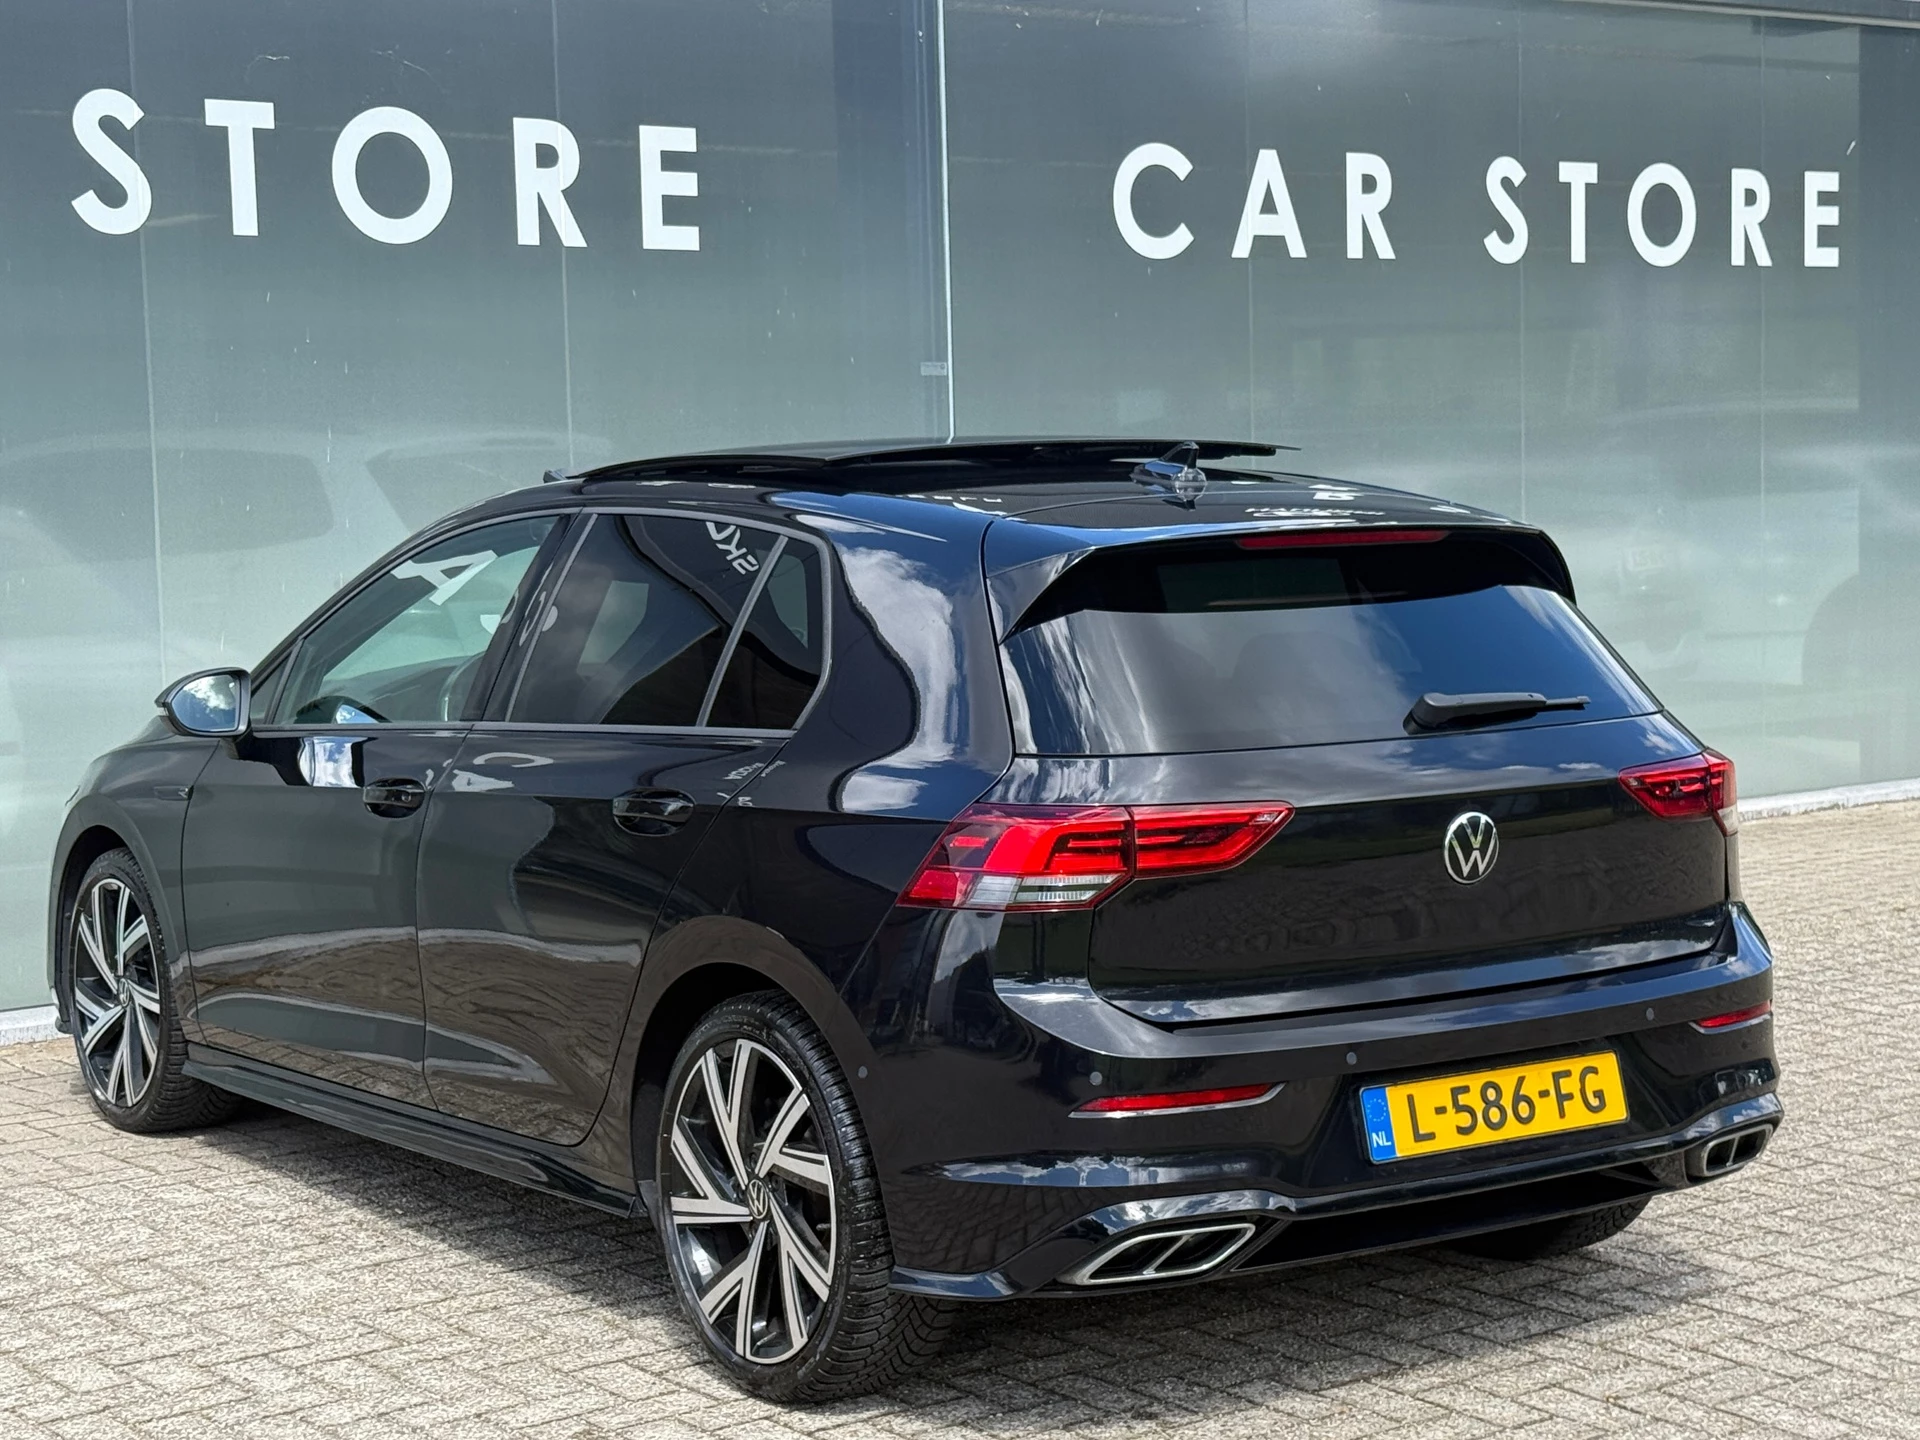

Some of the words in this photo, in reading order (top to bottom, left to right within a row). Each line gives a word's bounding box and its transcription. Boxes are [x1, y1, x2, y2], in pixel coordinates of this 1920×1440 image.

[71, 88, 701, 251] STORE
[1113, 142, 1396, 260] CAR
[1483, 156, 1841, 268] STORE
[1444, 811, 1499, 884] VW
[1372, 1131, 1392, 1148] NL
[1406, 1065, 1607, 1143] L-586-FG
